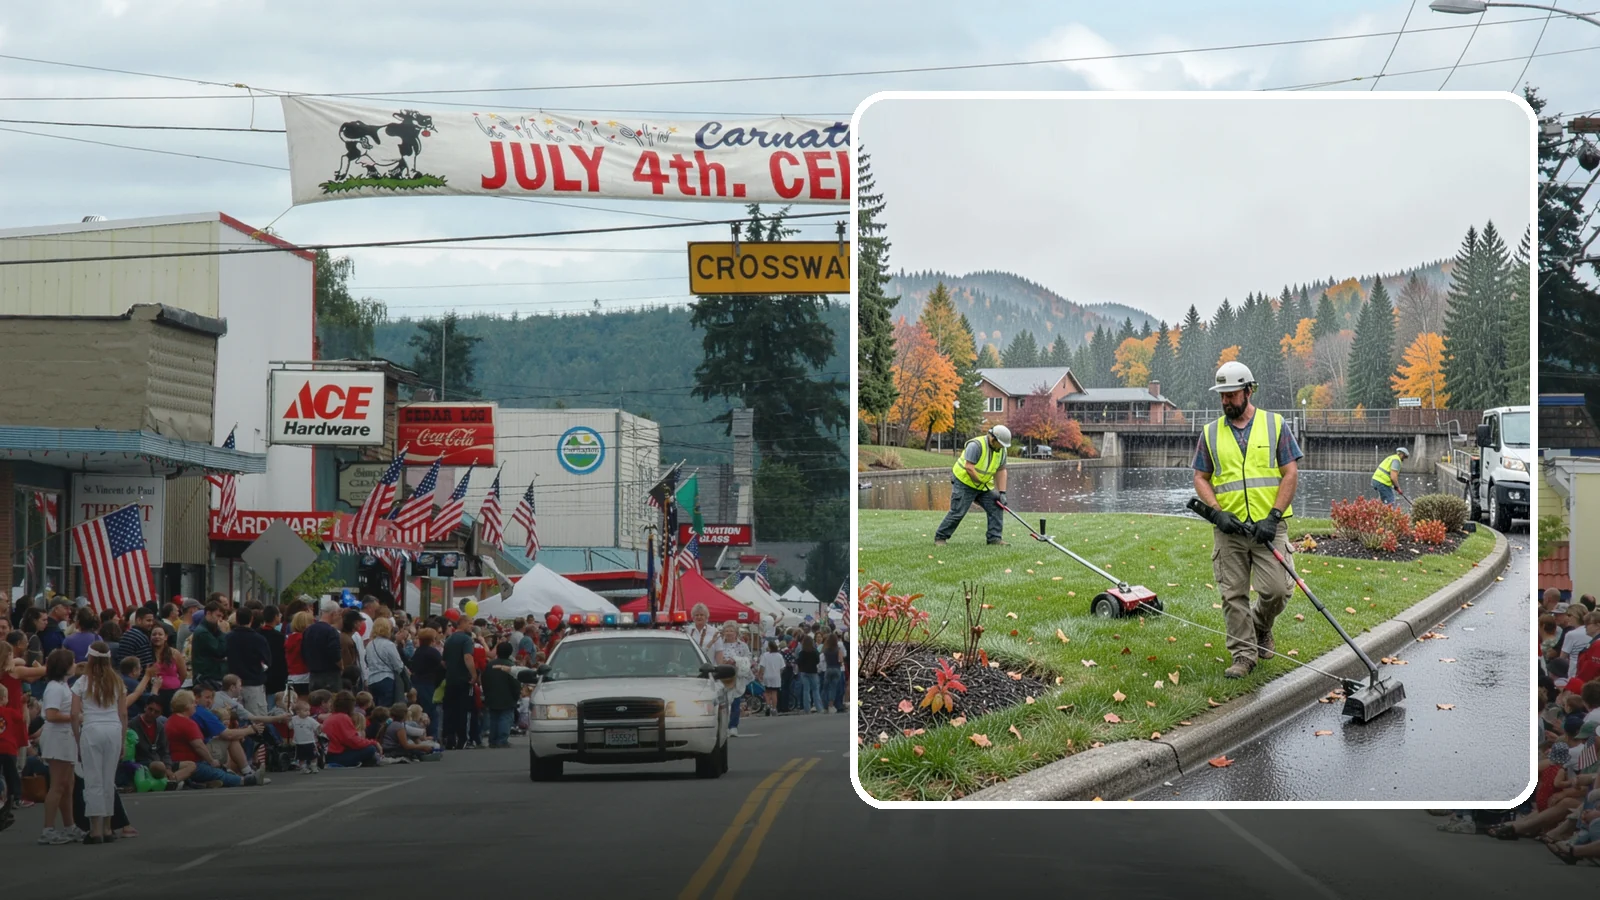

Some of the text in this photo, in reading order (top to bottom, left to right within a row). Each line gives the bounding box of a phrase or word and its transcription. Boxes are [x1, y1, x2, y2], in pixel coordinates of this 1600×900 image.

[695, 121, 850, 149] Carnat
[481, 140, 605, 192] JULY
[632, 150, 746, 198] 4th.
[697, 254, 850, 280] CROSSWA
[282, 380, 373, 420] ACE
[405, 409, 485, 422] CEDAR LOG
[283, 421, 370, 436] Hardware
[96, 485, 124, 495] Vincent
[126, 486, 136, 495] de
[138, 486, 155, 495] Paul
[81, 502, 154, 522] THT
[212, 516, 330, 535] HARDARE
[688, 526, 741, 535] CRNATION
[699, 535, 730, 544] GLASS
